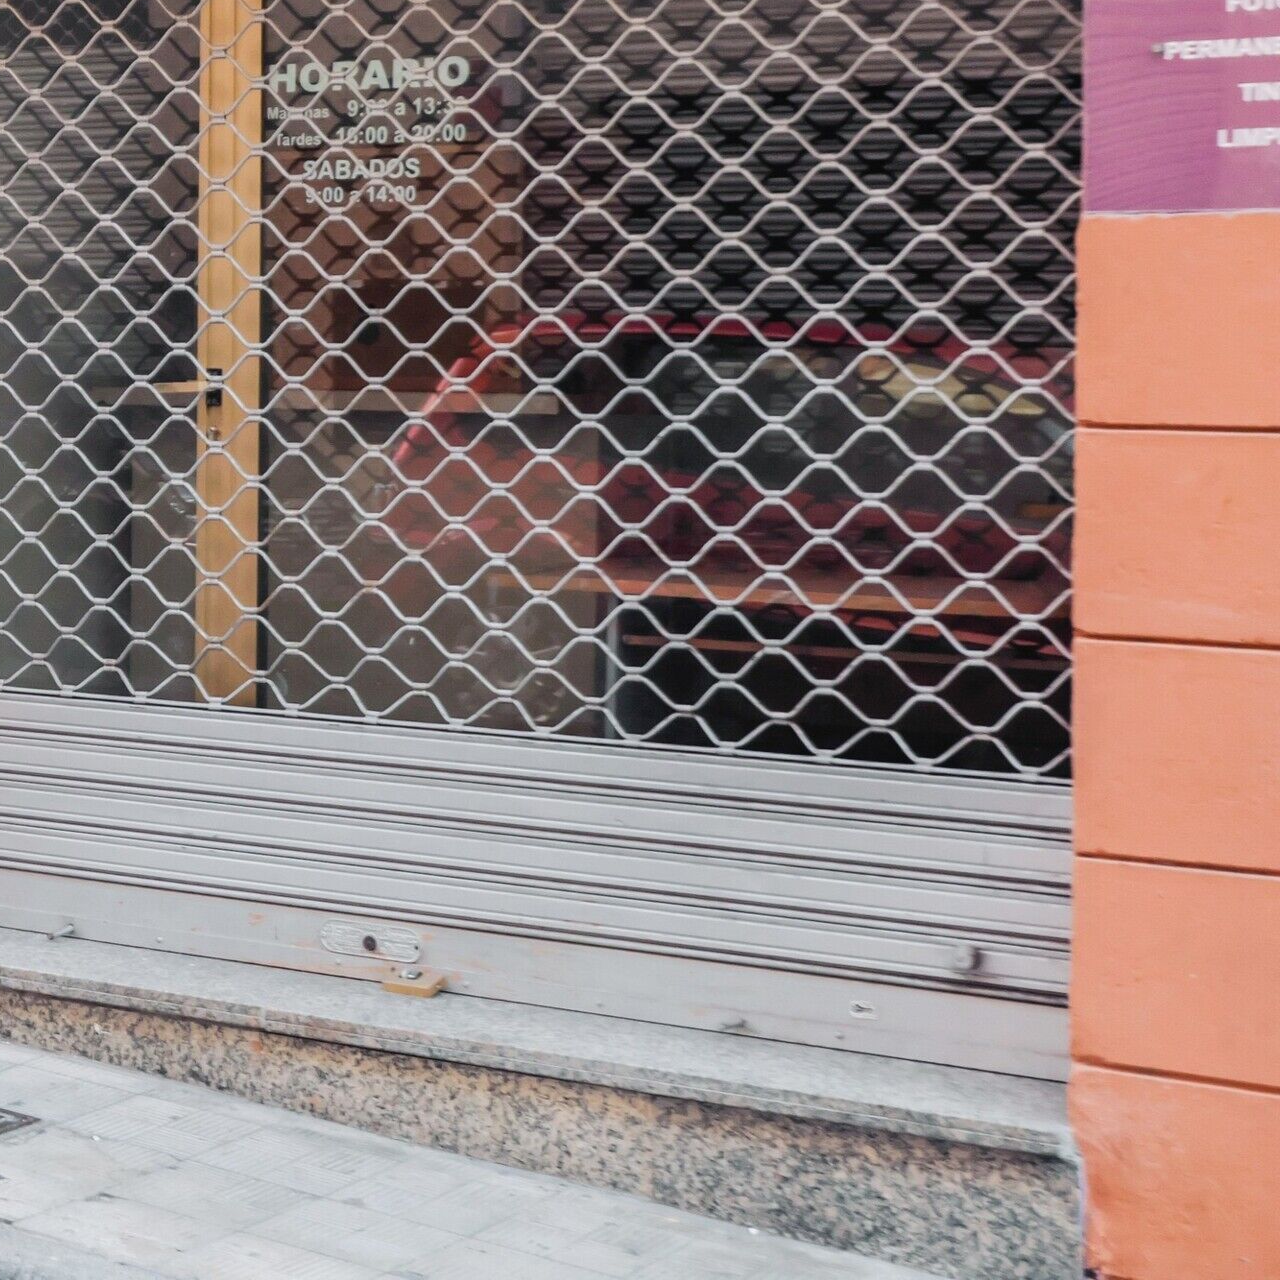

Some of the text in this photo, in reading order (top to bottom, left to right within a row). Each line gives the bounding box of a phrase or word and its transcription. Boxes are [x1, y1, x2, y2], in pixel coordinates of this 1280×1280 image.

[267, 55, 471, 94] HORARIO
[393, 102, 406, 116] a
[274, 132, 322, 147] Tardes
[393, 129, 406, 143] a
[303, 157, 421, 180] SABADOS
